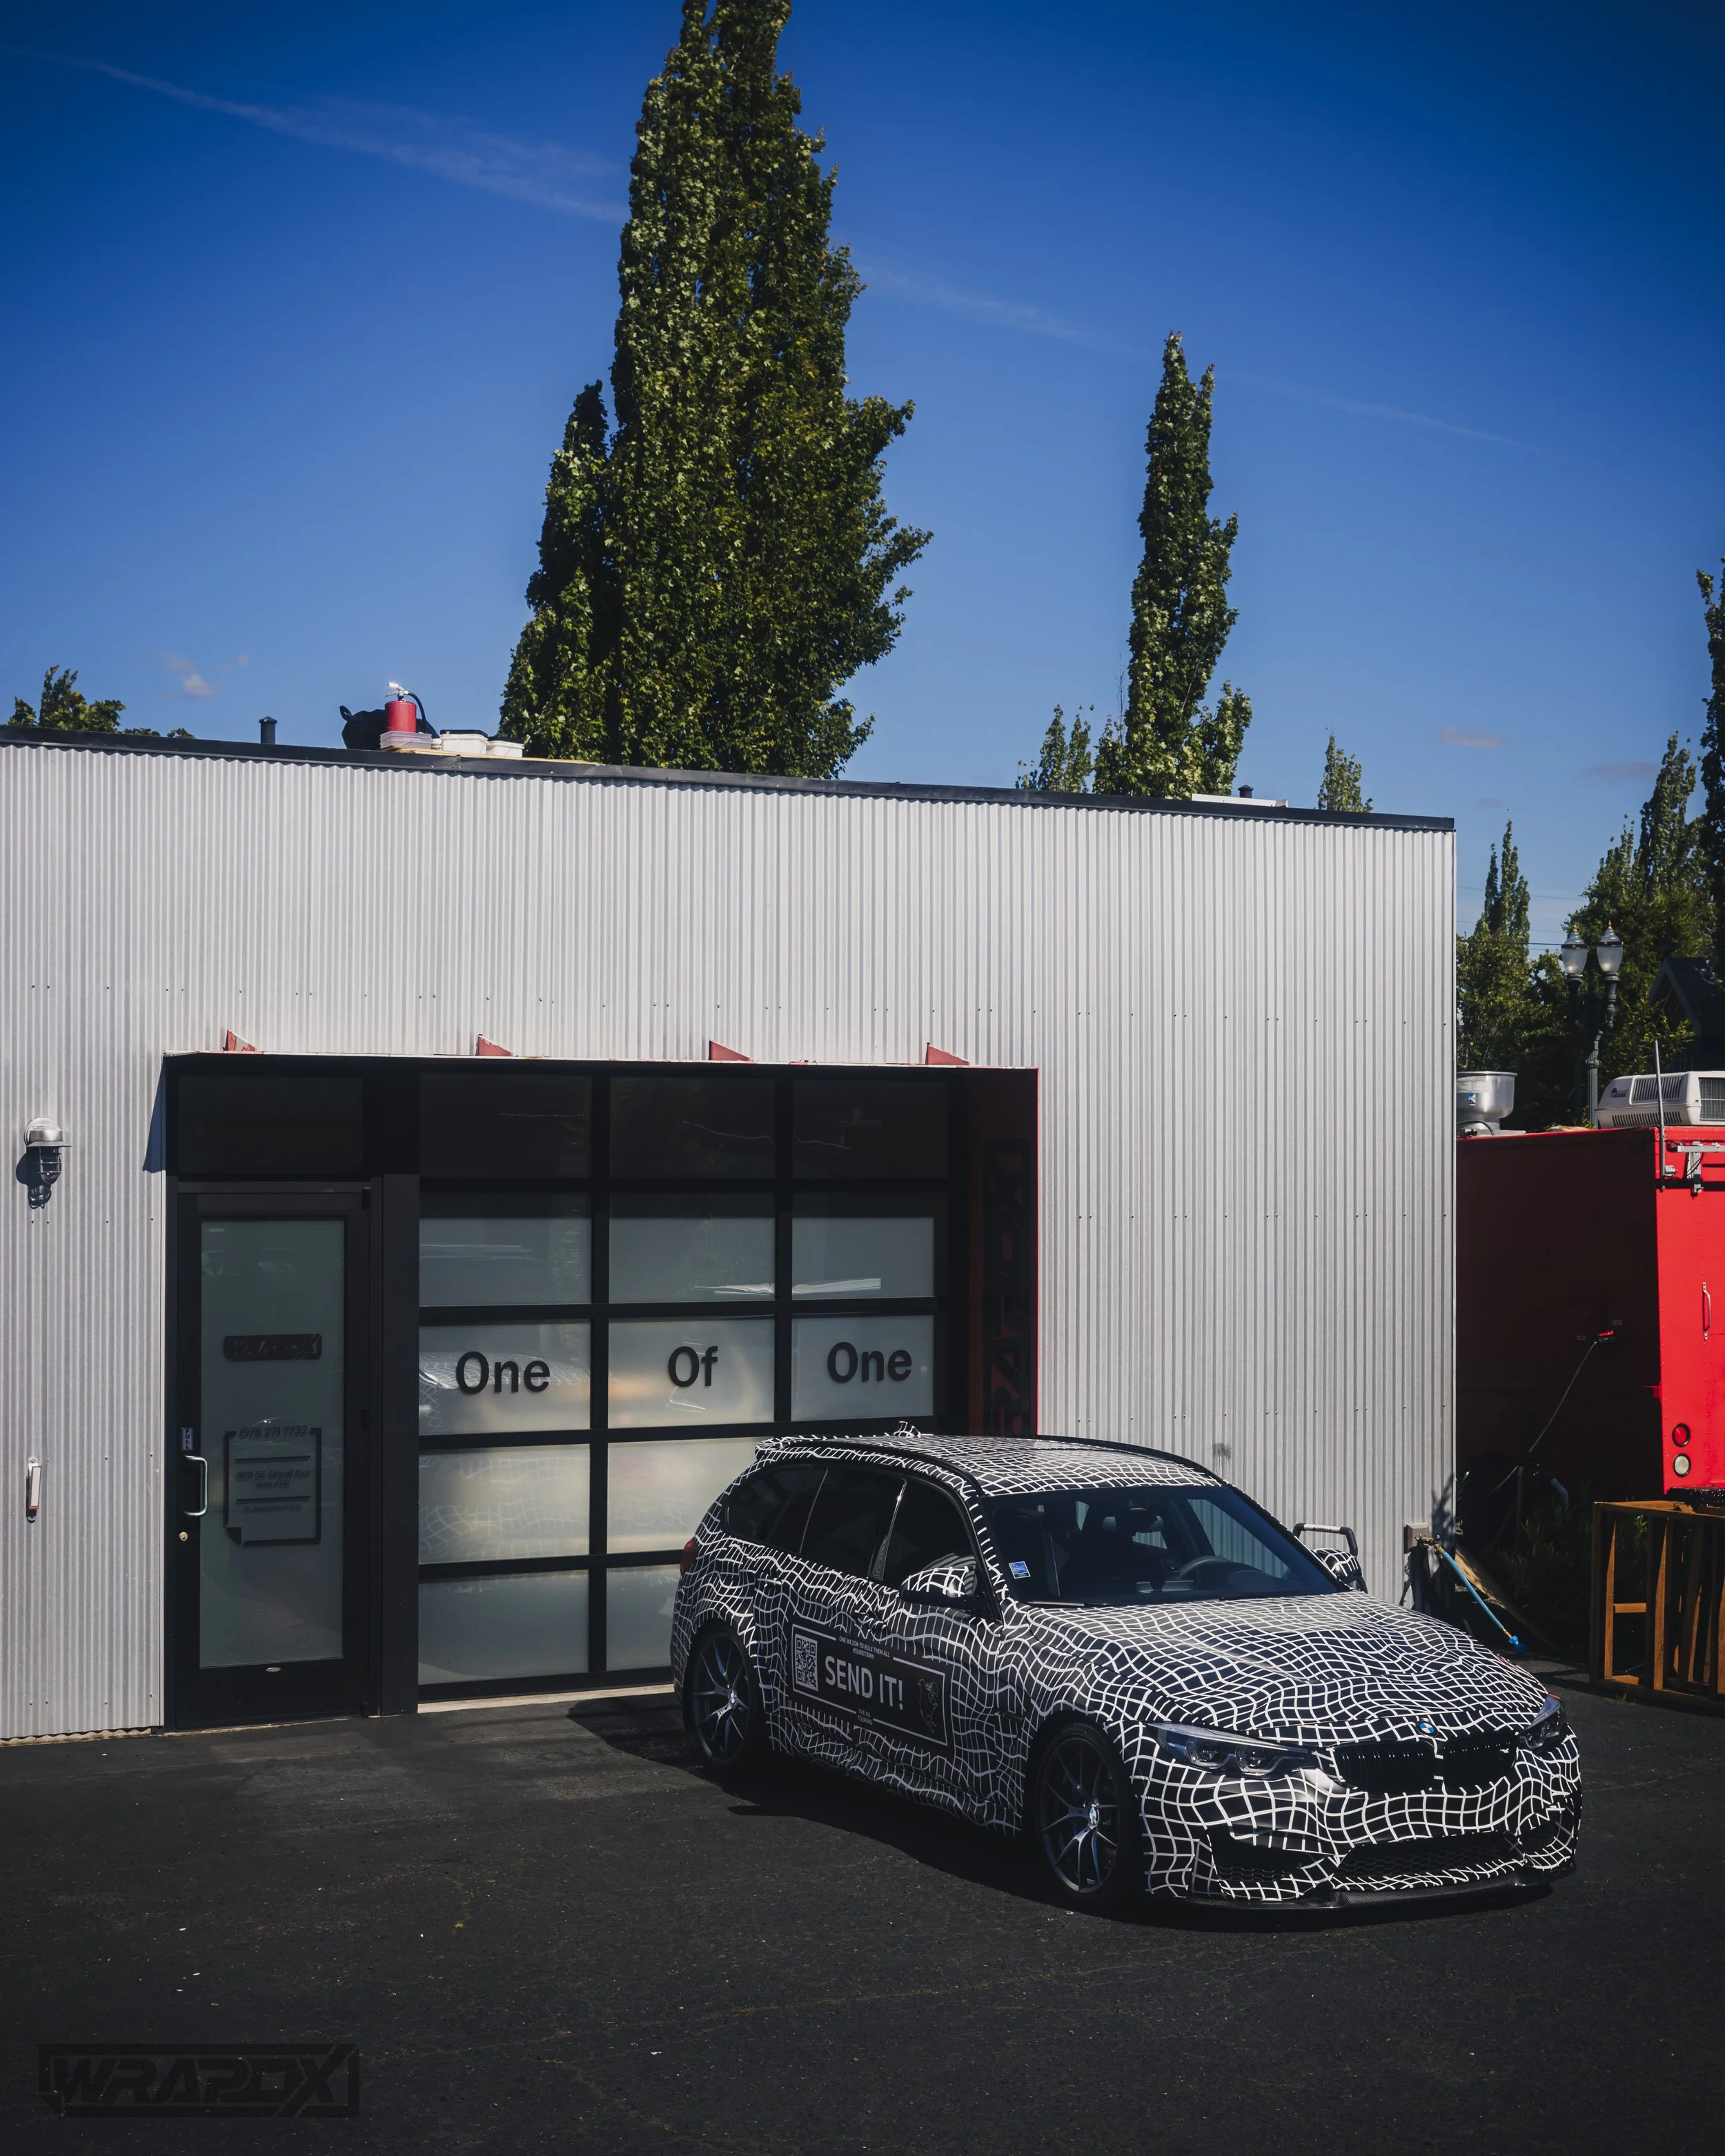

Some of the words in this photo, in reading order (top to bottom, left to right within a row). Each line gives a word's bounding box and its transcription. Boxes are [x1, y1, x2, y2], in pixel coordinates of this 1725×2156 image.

[455, 1351, 551, 1394] One
[667, 1345, 718, 1387] Of
[827, 1341, 912, 1384] One
[865, 1644, 873, 1652] RULE
[874, 1647, 883, 1655] THEM
[825, 1655, 874, 1699] SEND
[879, 1673, 903, 1711] IT!
